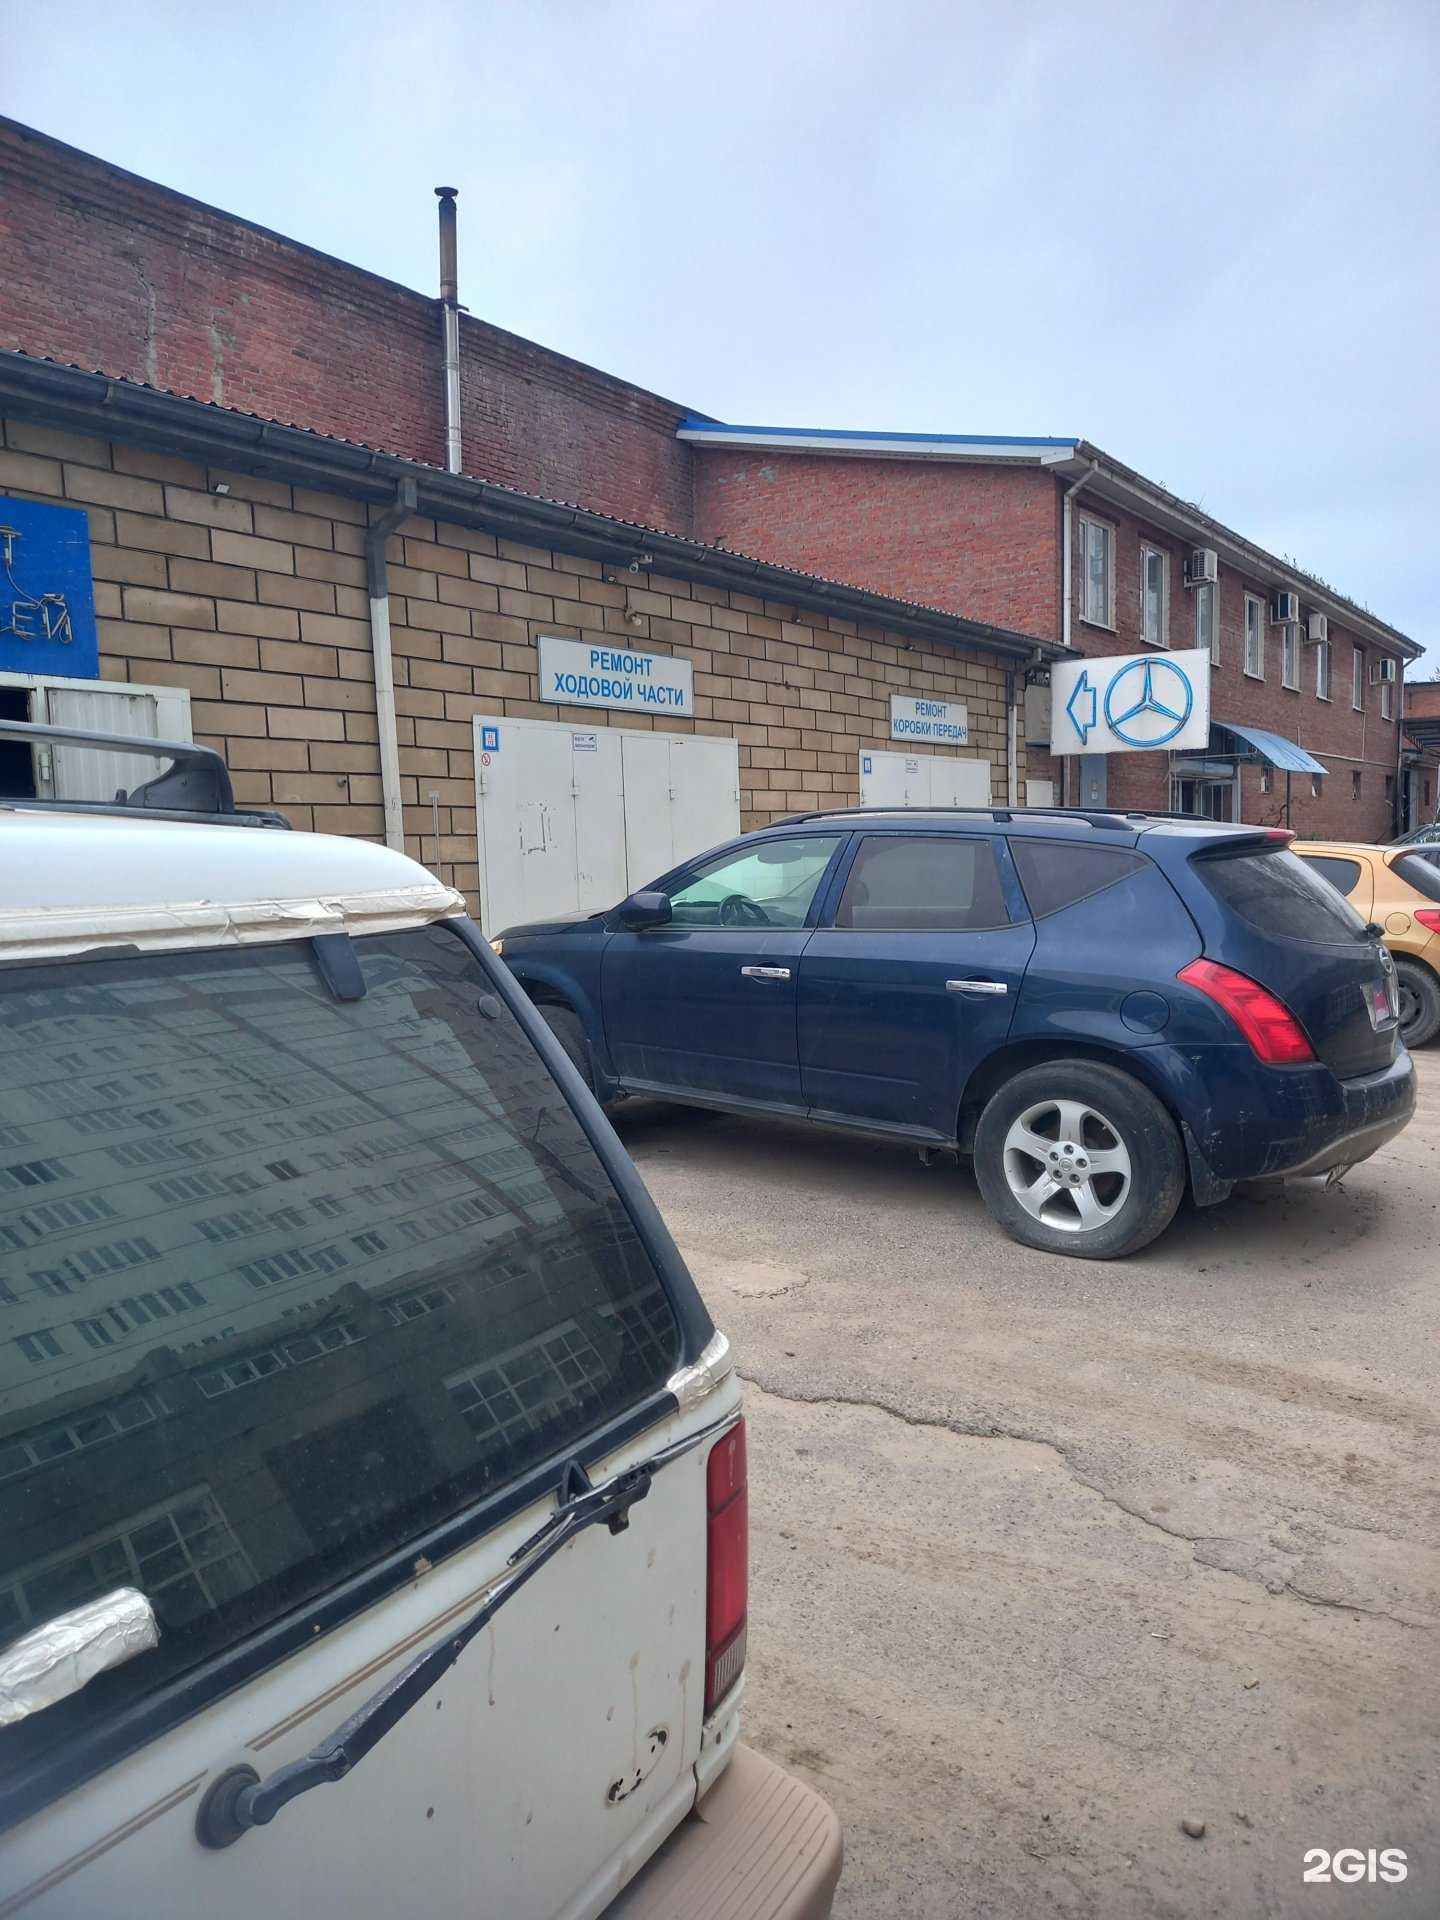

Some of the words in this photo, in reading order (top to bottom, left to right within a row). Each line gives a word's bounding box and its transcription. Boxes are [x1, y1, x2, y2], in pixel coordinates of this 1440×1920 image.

[590, 650, 653, 677] РЕМОНТ
[554, 672, 633, 700] ХОДОВОЙ
[637, 683, 684, 706] ЧАСТИ
[915, 702, 948, 719] РЕМОНТ
[893, 719, 931, 736] КОРОБКИ
[933, 723, 967, 739] ПЕРЕДАЧ
